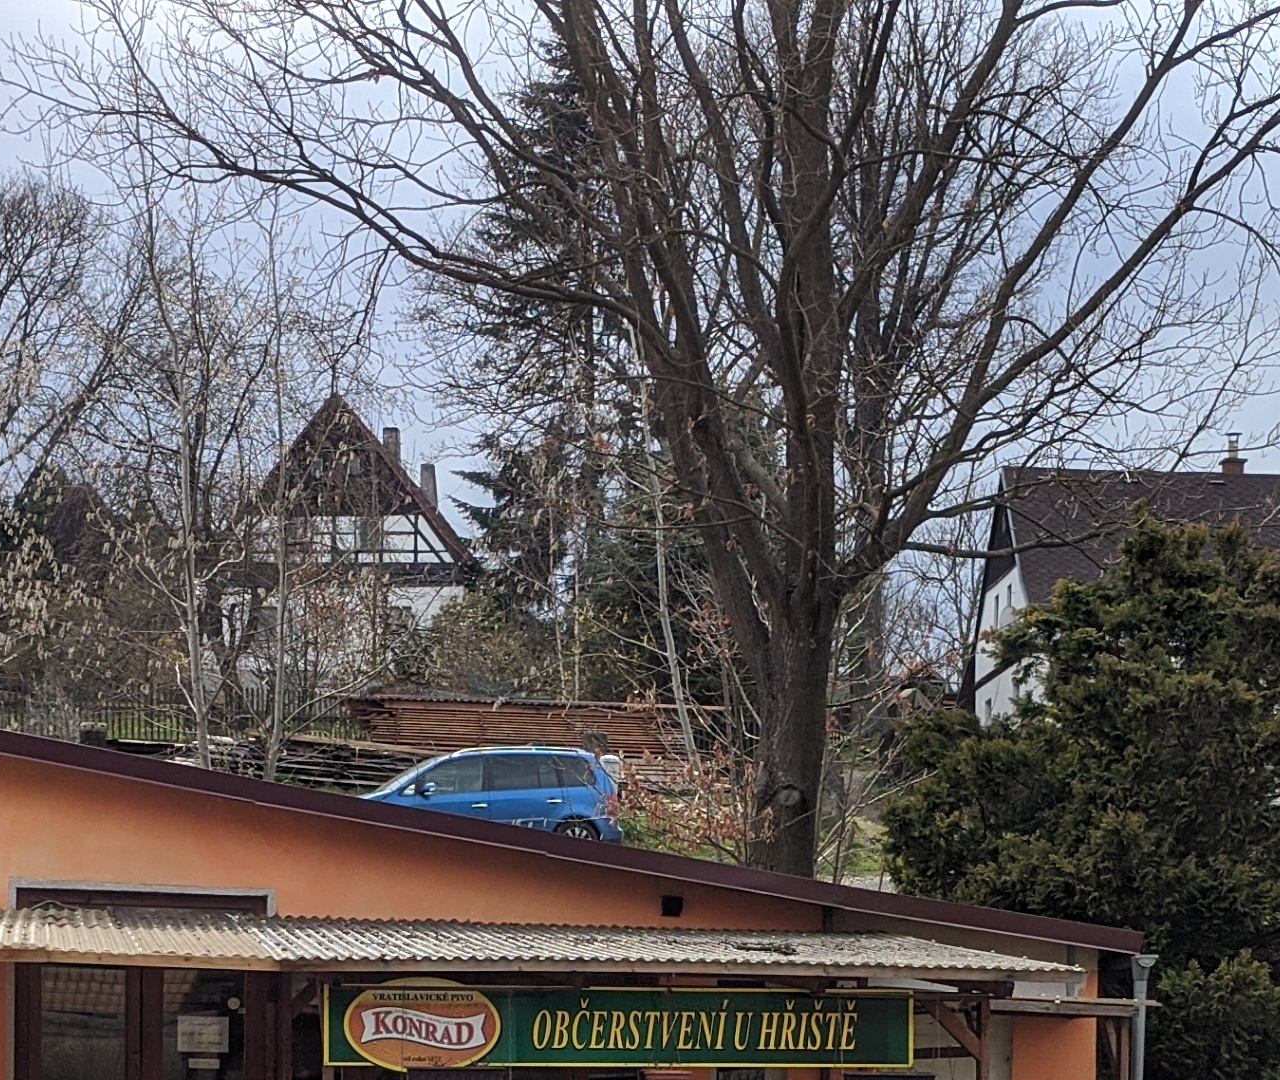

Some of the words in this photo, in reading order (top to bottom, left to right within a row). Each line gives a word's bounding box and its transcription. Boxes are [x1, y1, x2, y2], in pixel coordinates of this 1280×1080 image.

[451, 993, 474, 1001] PIVO
[372, 1010, 474, 1046] KONRAD
[532, 998, 729, 1050] OBČERSTVENÍ
[734, 1012, 754, 1050] U
[757, 1000, 858, 1050] HŘIŠTĚ
